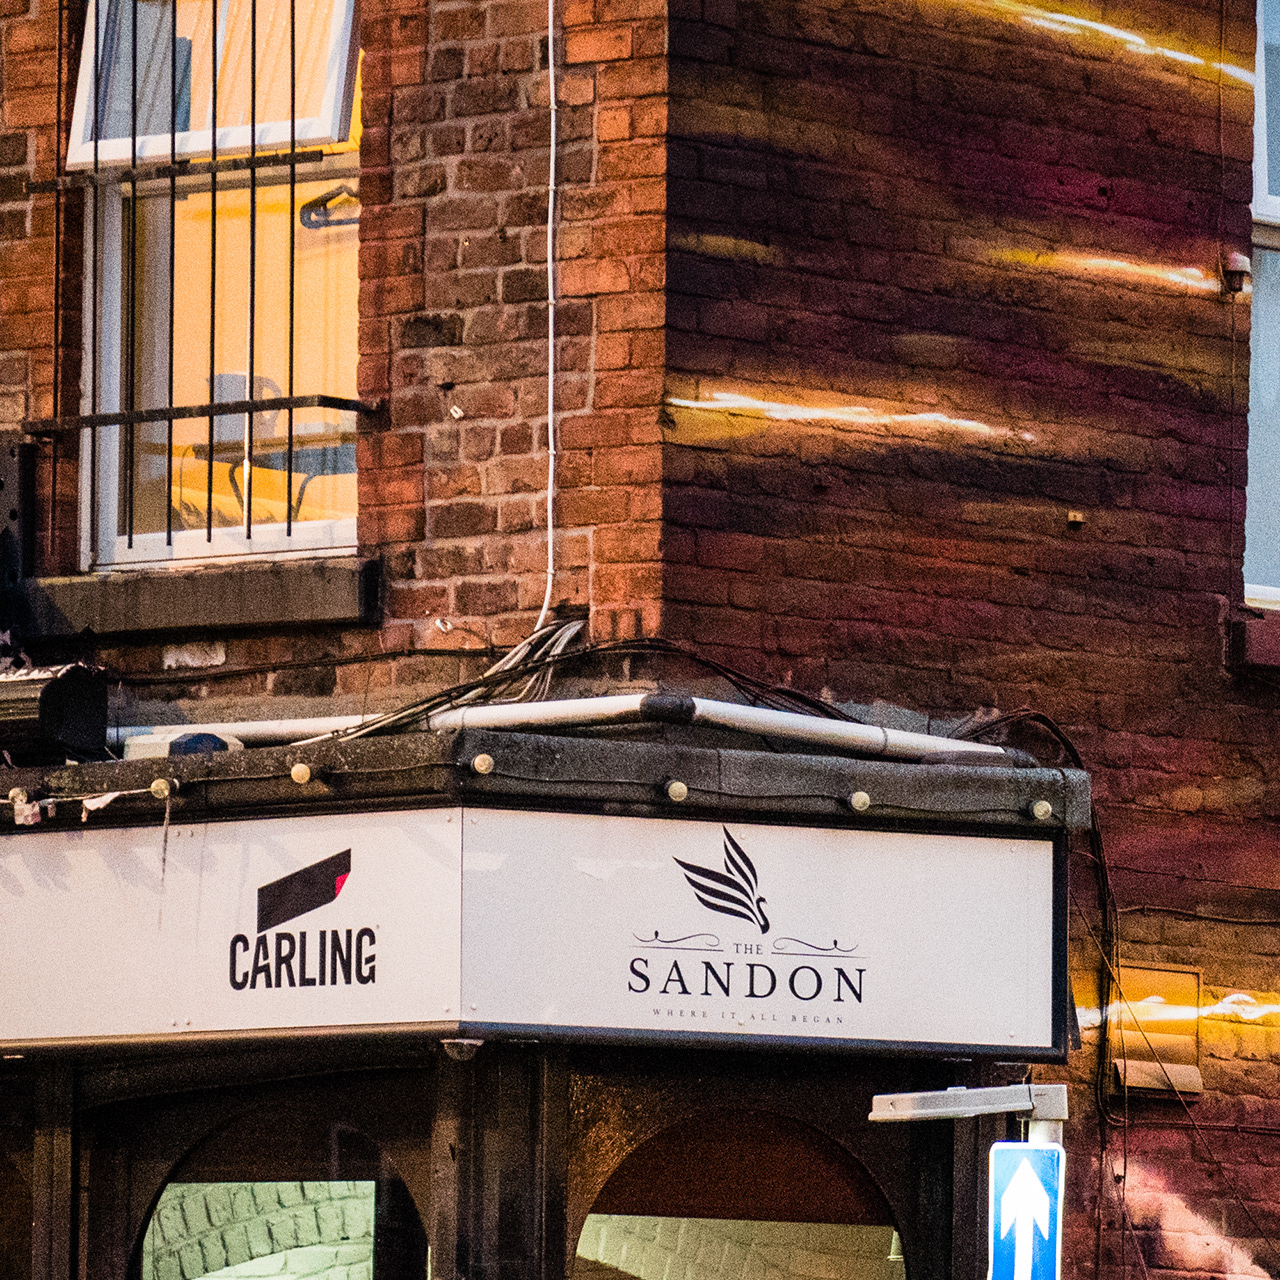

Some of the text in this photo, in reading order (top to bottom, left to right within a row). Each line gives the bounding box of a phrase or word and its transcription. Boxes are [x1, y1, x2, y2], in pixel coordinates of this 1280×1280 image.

[229, 927, 376, 991] CARLING
[733, 943, 763, 955] THE
[628, 957, 867, 1003] SANDON
[652, 1008, 844, 1024] WHERE IT ALL BEGAN
